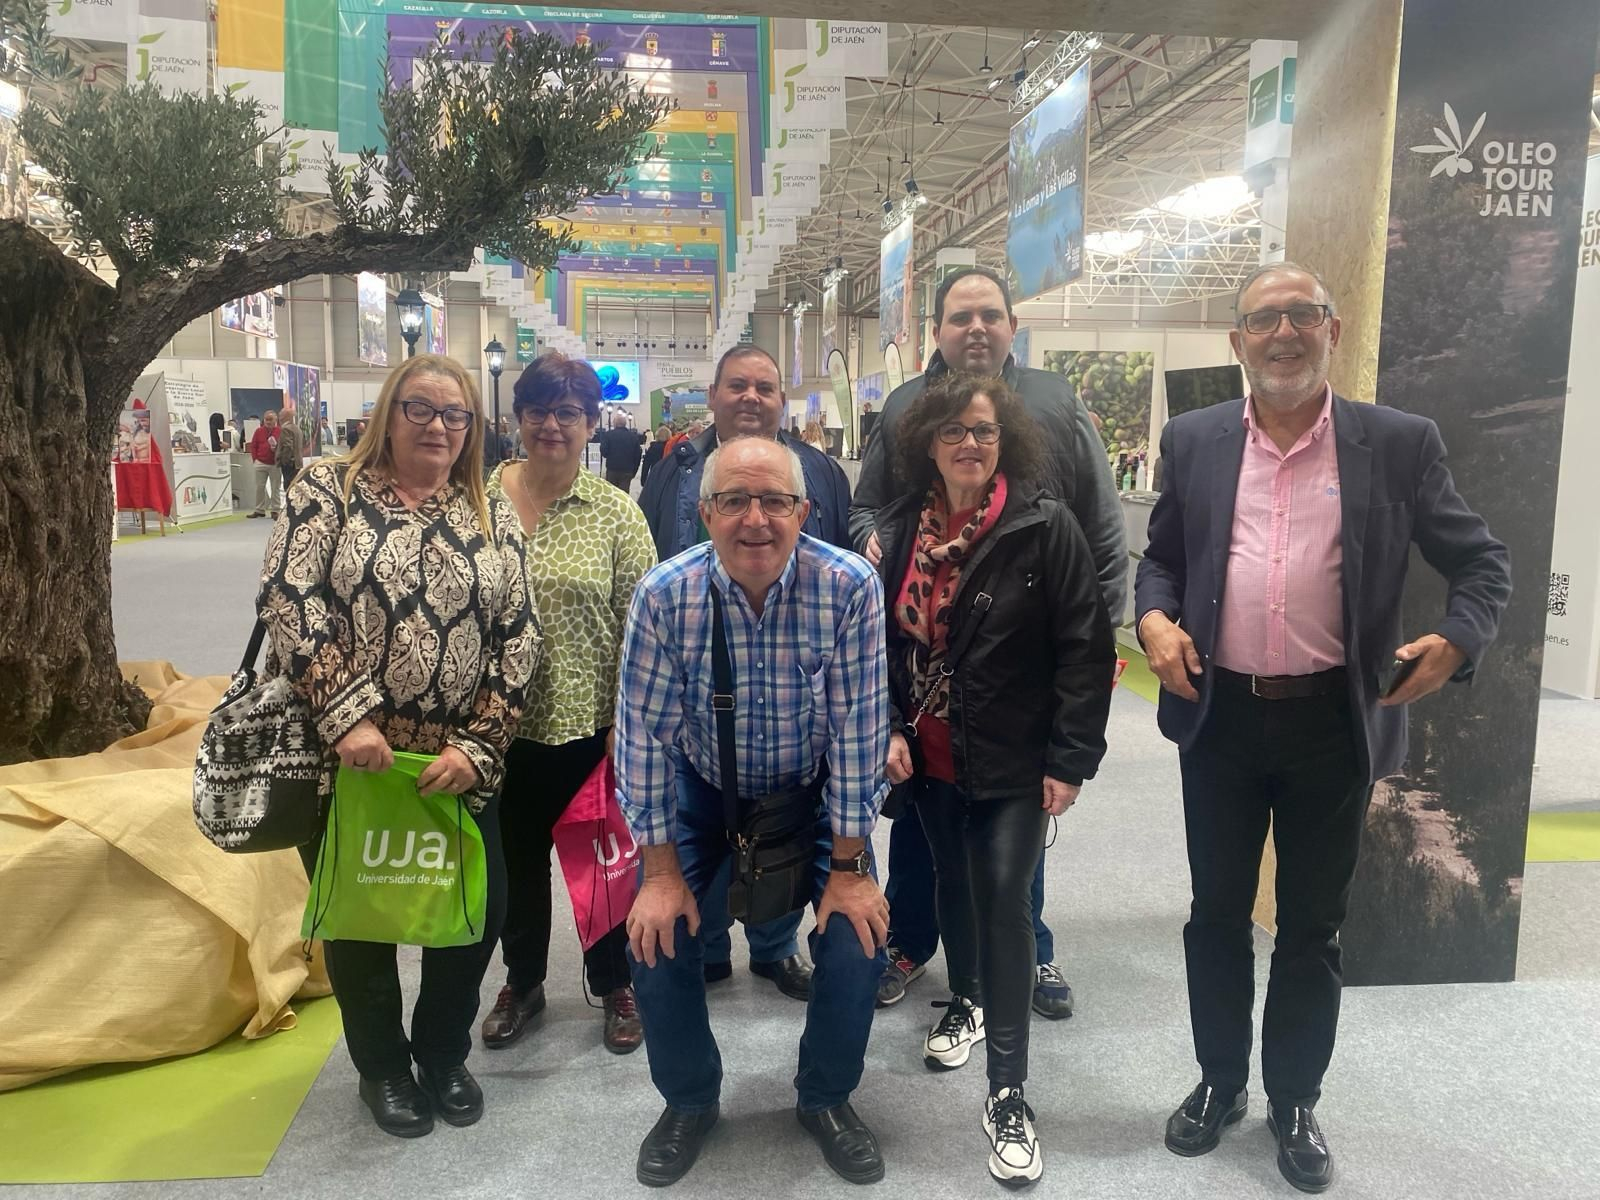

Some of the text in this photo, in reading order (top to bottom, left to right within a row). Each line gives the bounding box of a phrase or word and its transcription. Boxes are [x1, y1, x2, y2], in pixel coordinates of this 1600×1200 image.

[831, 26, 881, 34] DIPUTACIÓN
[843, 36, 865, 44] JAÉN
[151, 55, 201, 66] DIPUTACIÓN
[796, 85, 841, 93] DIPUTACIÓN
[1482, 140, 1557, 166] OLEO
[1482, 167, 1554, 192] TOUR
[1015, 203, 1022, 218] La
[1023, 193, 1040, 214] Loma
[1045, 181, 1057, 200] Las
[1057, 168, 1077, 191] Villas
[1479, 191, 1553, 217] JAÉN
[357, 873, 454, 887] Universidad de Jaén
